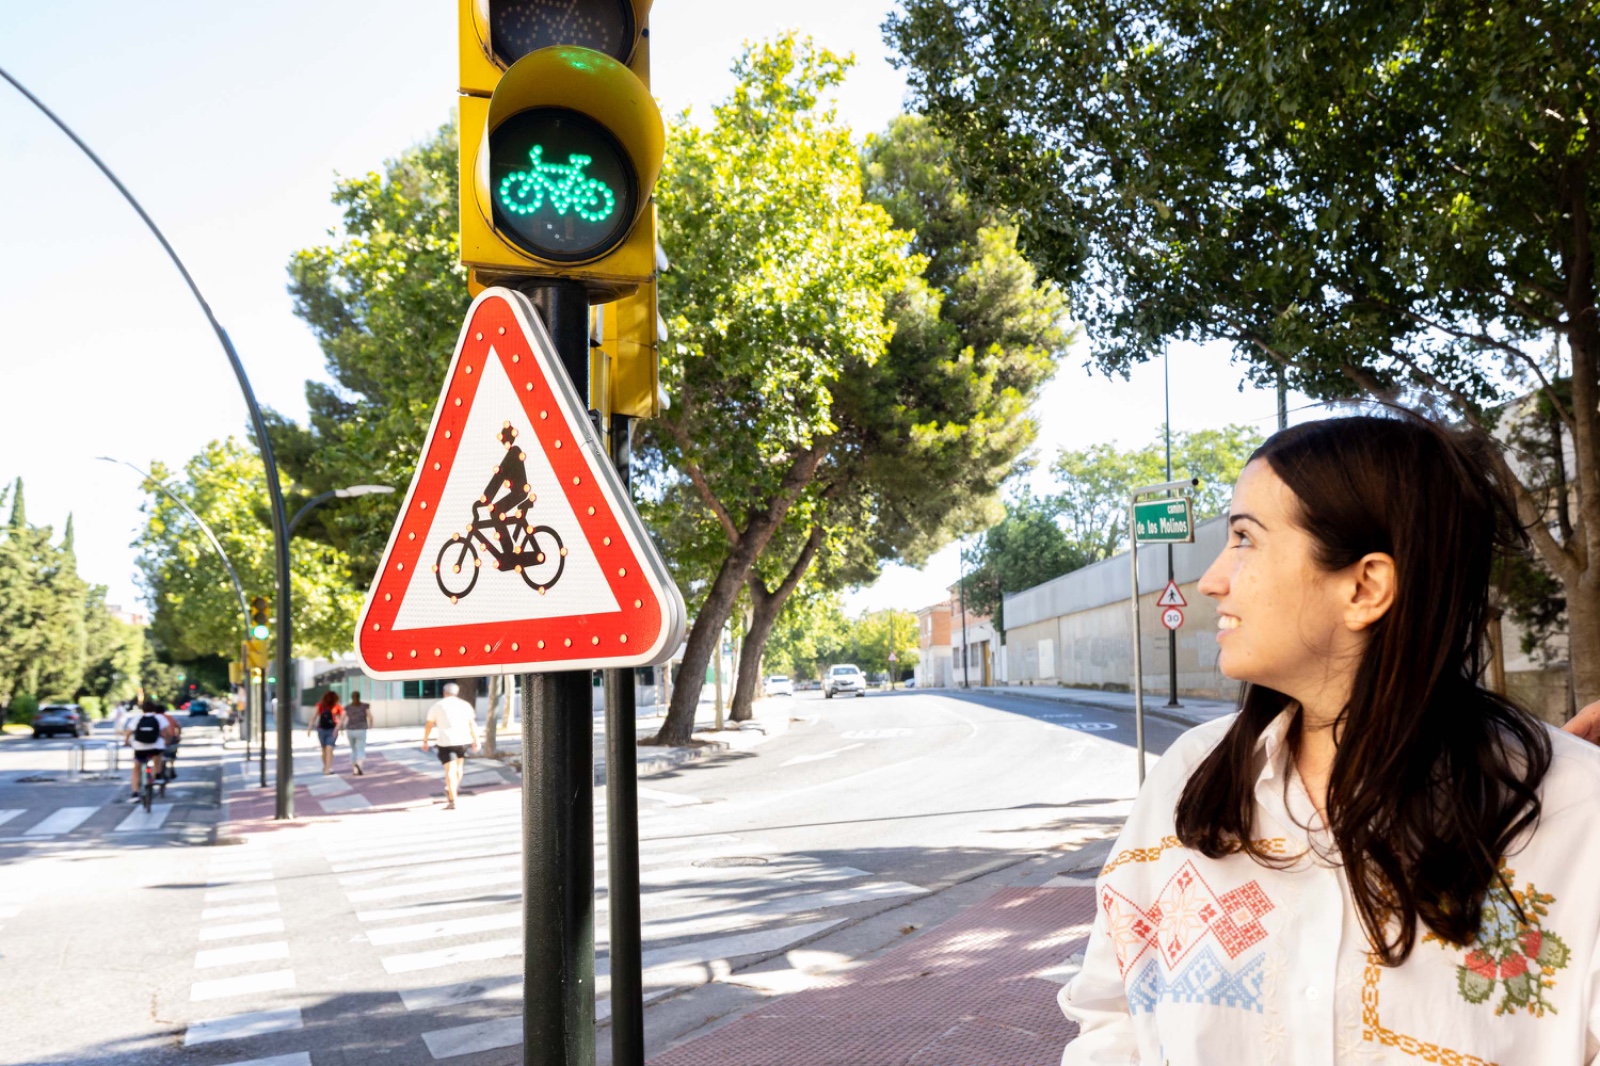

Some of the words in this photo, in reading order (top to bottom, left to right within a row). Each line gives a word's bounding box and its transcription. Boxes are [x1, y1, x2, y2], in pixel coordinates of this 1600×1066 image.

[1137, 521, 1145, 535] de
[1147, 519, 1158, 535] los
[1159, 517, 1187, 534] Molinos
[1167, 614, 1180, 623] 30
